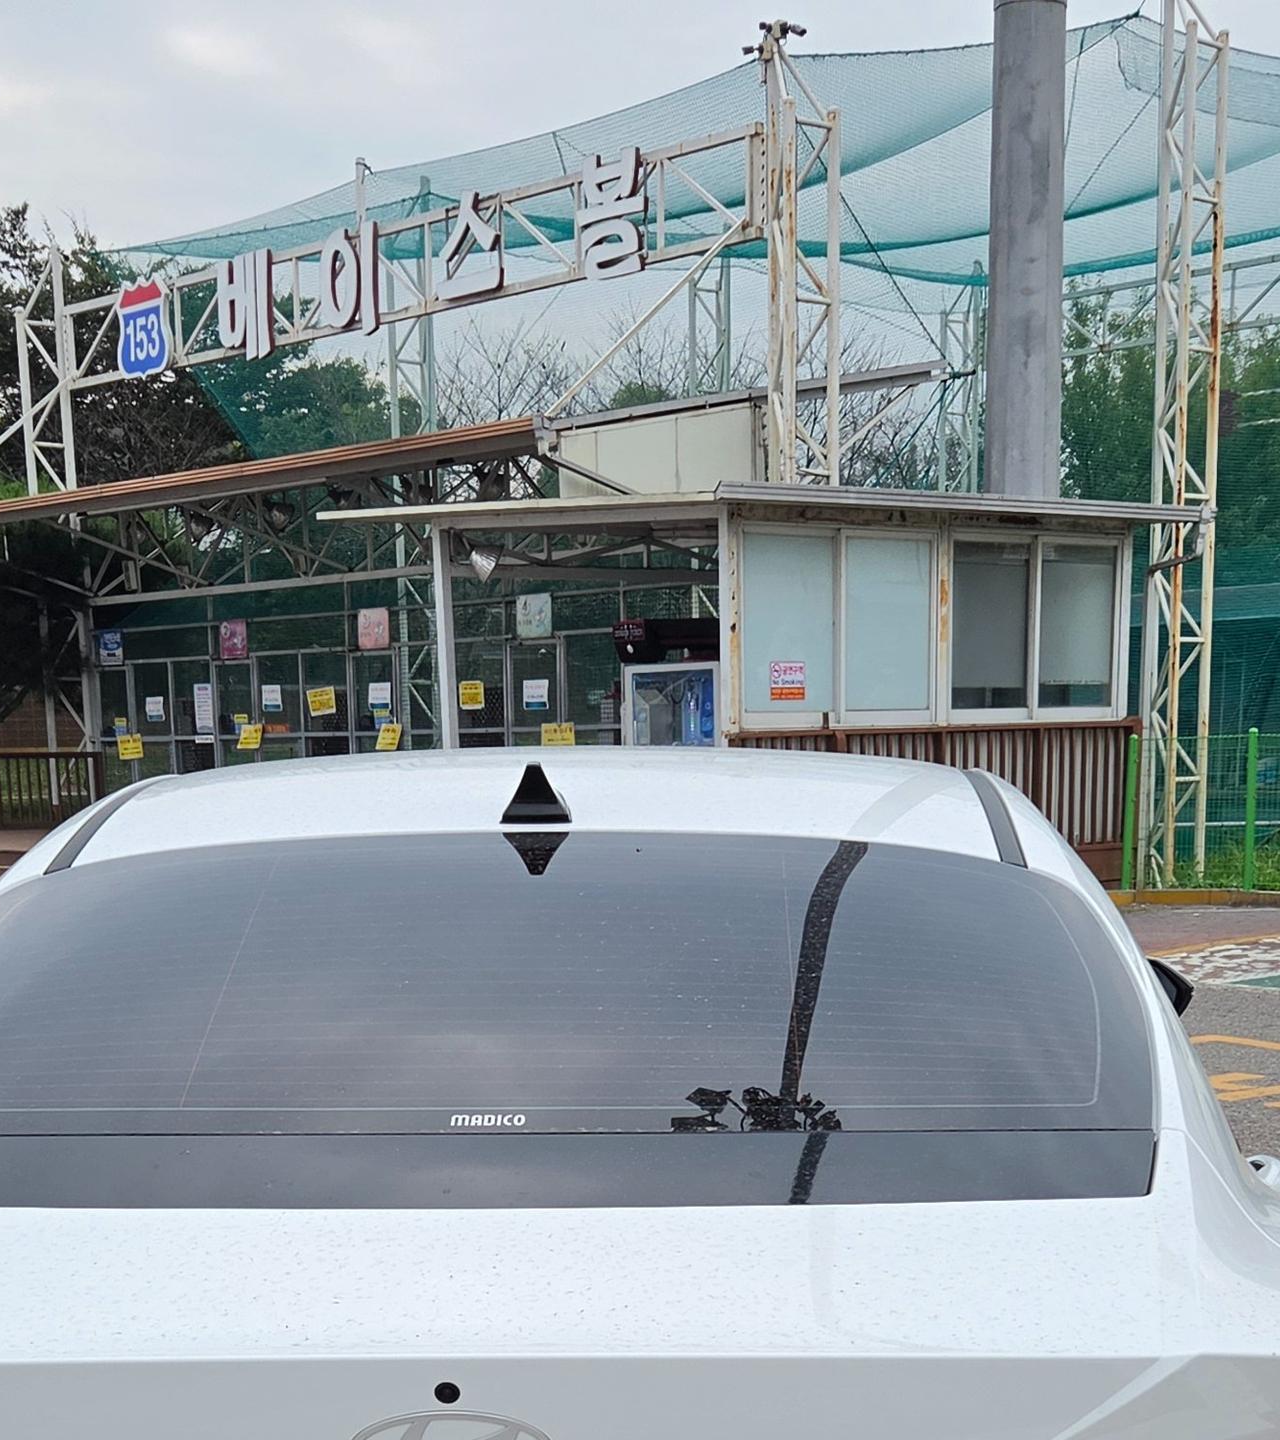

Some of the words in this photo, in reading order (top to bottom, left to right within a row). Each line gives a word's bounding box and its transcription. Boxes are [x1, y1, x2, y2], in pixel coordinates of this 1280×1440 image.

[216, 146, 649, 361] 베이스볼
[124, 313, 159, 363] 153
[449, 1113, 526, 1127] MADICO
